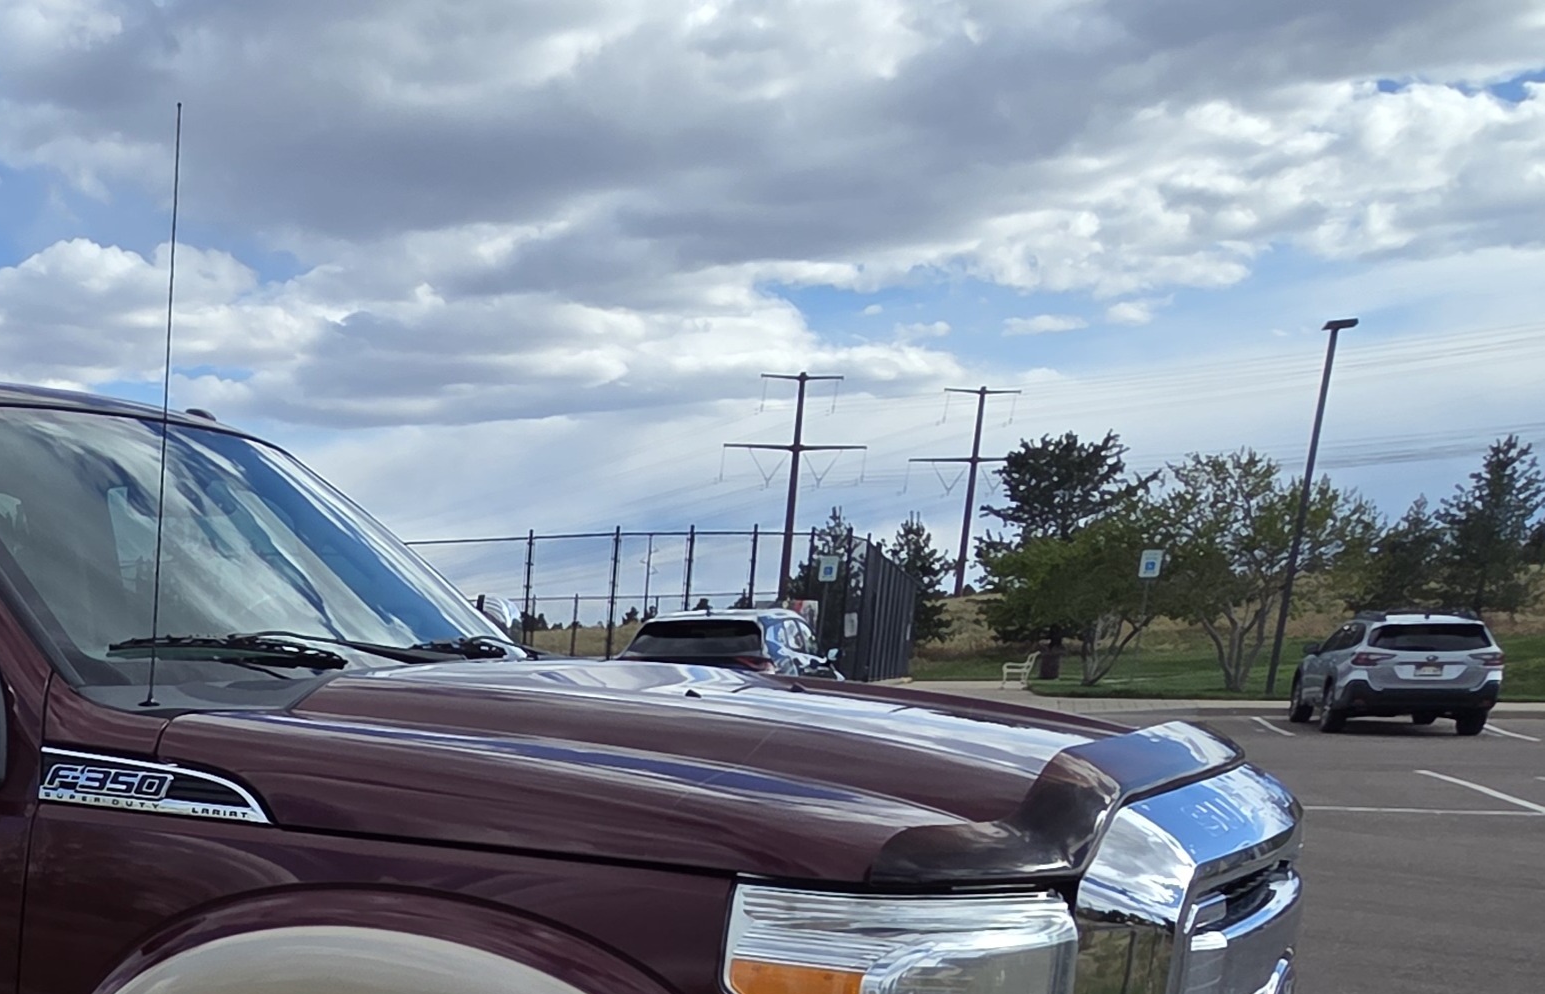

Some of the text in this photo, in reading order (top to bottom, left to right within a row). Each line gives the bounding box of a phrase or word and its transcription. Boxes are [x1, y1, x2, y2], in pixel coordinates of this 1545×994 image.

[44, 791, 160, 810] SUPER DUTY
[191, 807, 249, 819] LARIAT
